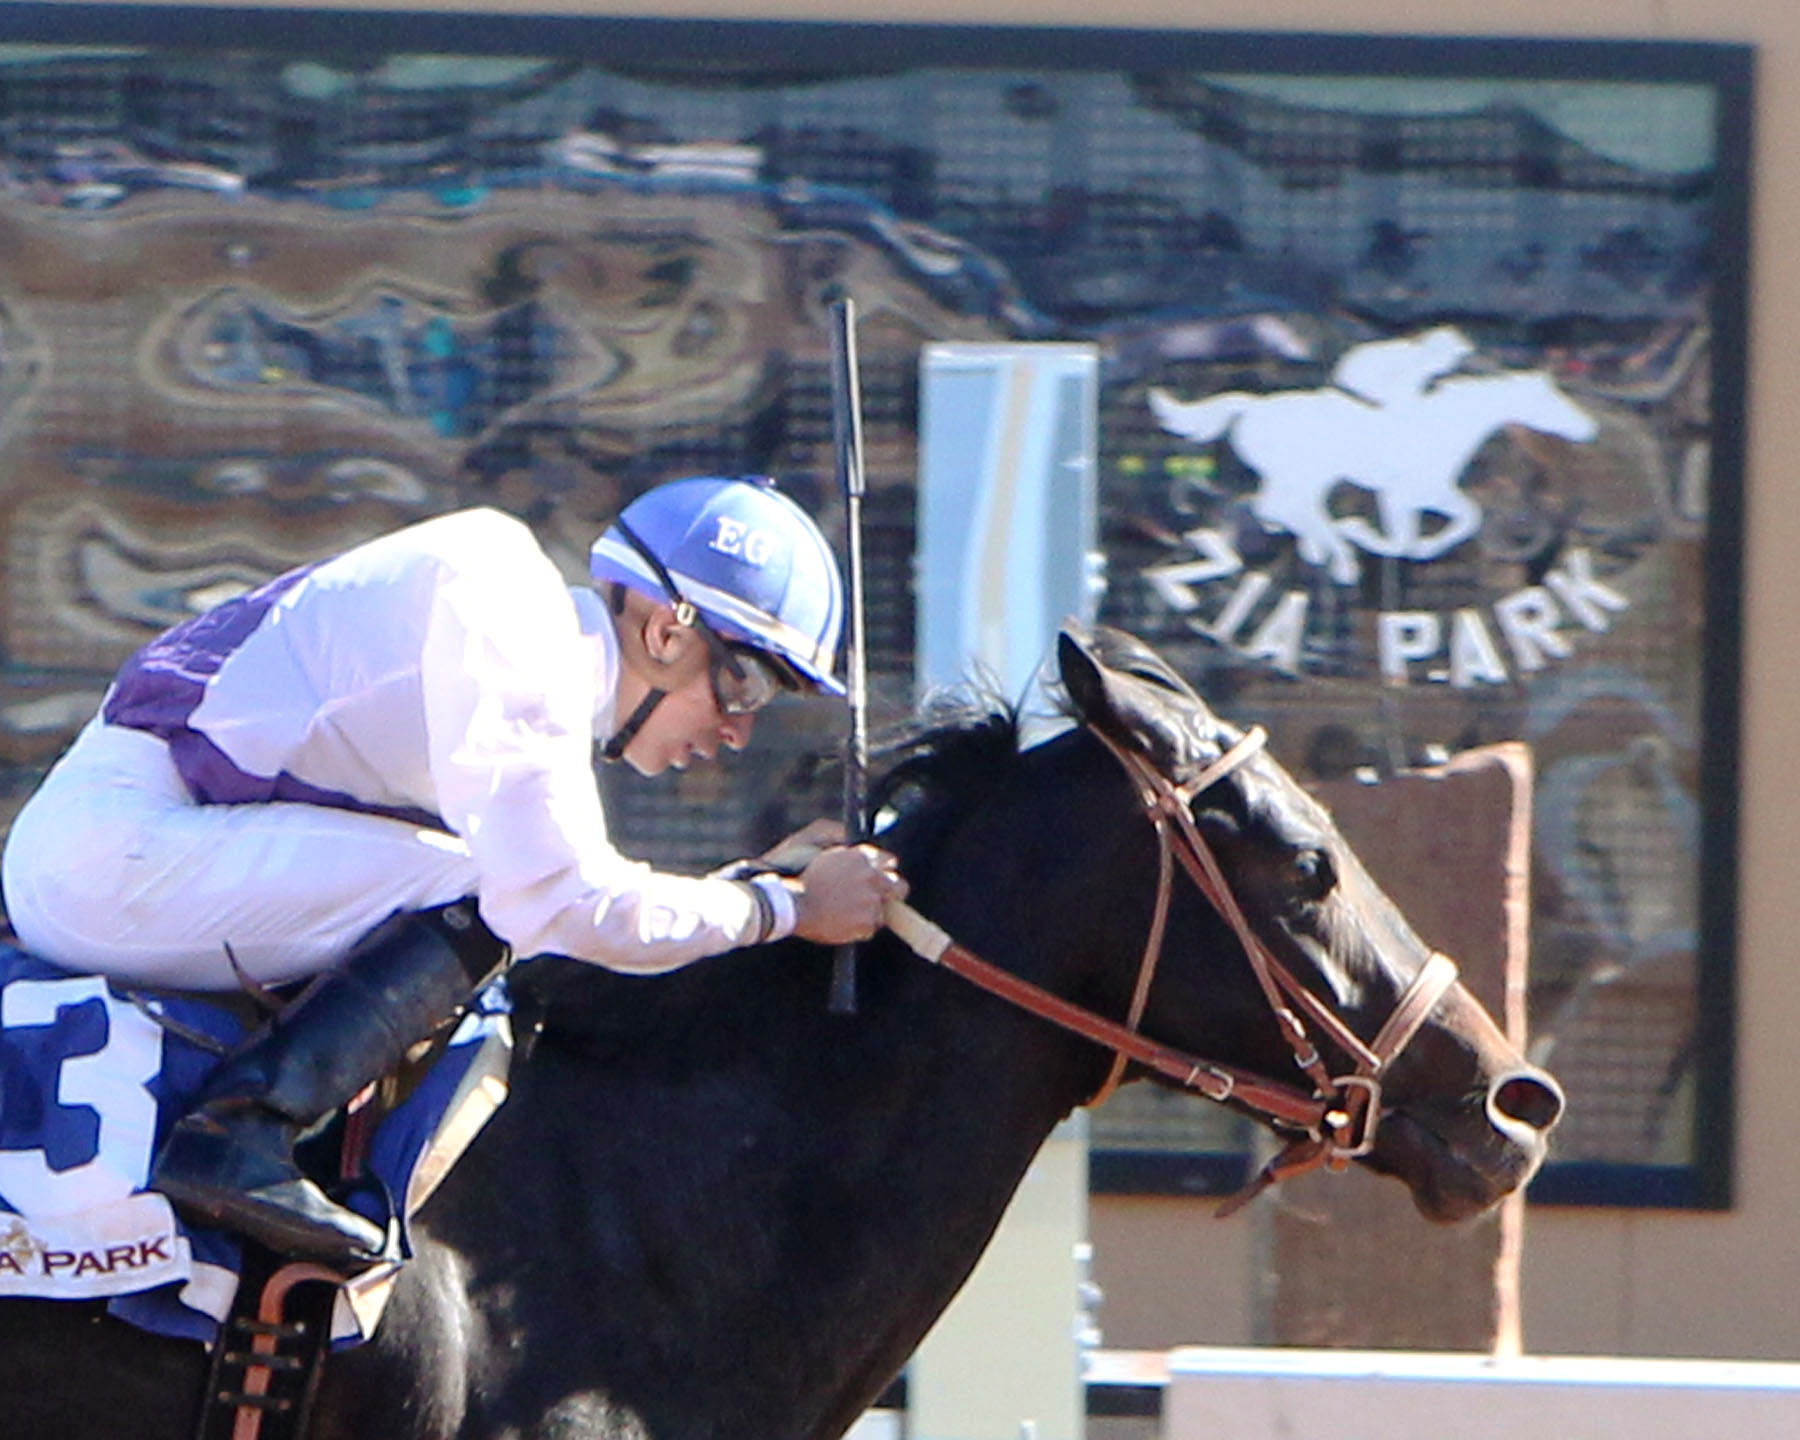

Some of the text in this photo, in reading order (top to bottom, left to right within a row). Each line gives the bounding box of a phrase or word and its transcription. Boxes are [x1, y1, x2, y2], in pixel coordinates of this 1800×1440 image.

[1142, 529, 1630, 688] ZIA PARK
[42, 1236, 171, 1277] PARK
